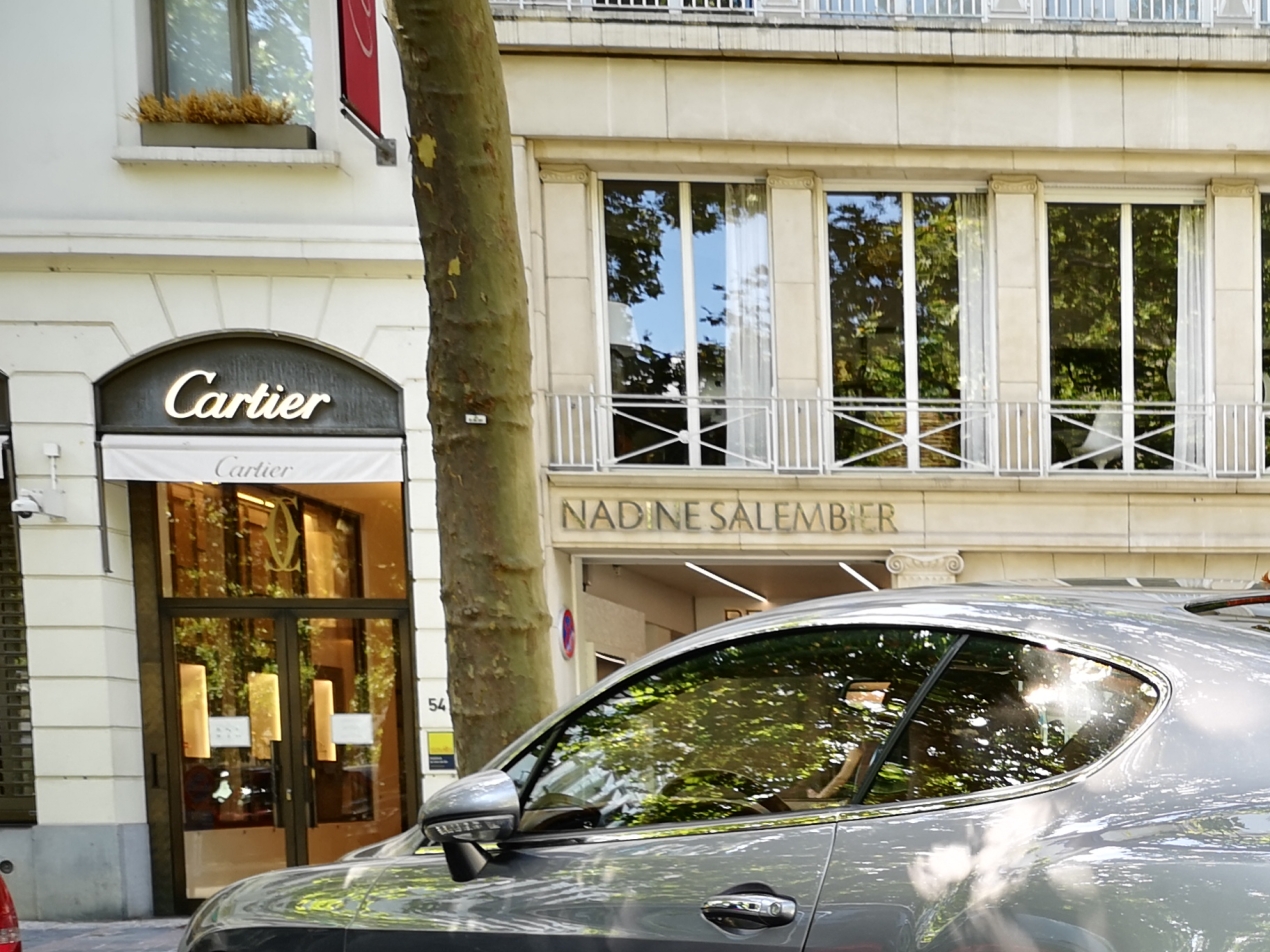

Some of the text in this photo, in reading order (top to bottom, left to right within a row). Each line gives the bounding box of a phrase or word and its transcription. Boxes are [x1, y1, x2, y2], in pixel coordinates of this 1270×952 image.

[164, 369, 331, 420] Cartier
[215, 455, 294, 478] Cartier
[562, 499, 898, 533] NADINE SALEMBIER
[428, 698, 446, 712] 54
